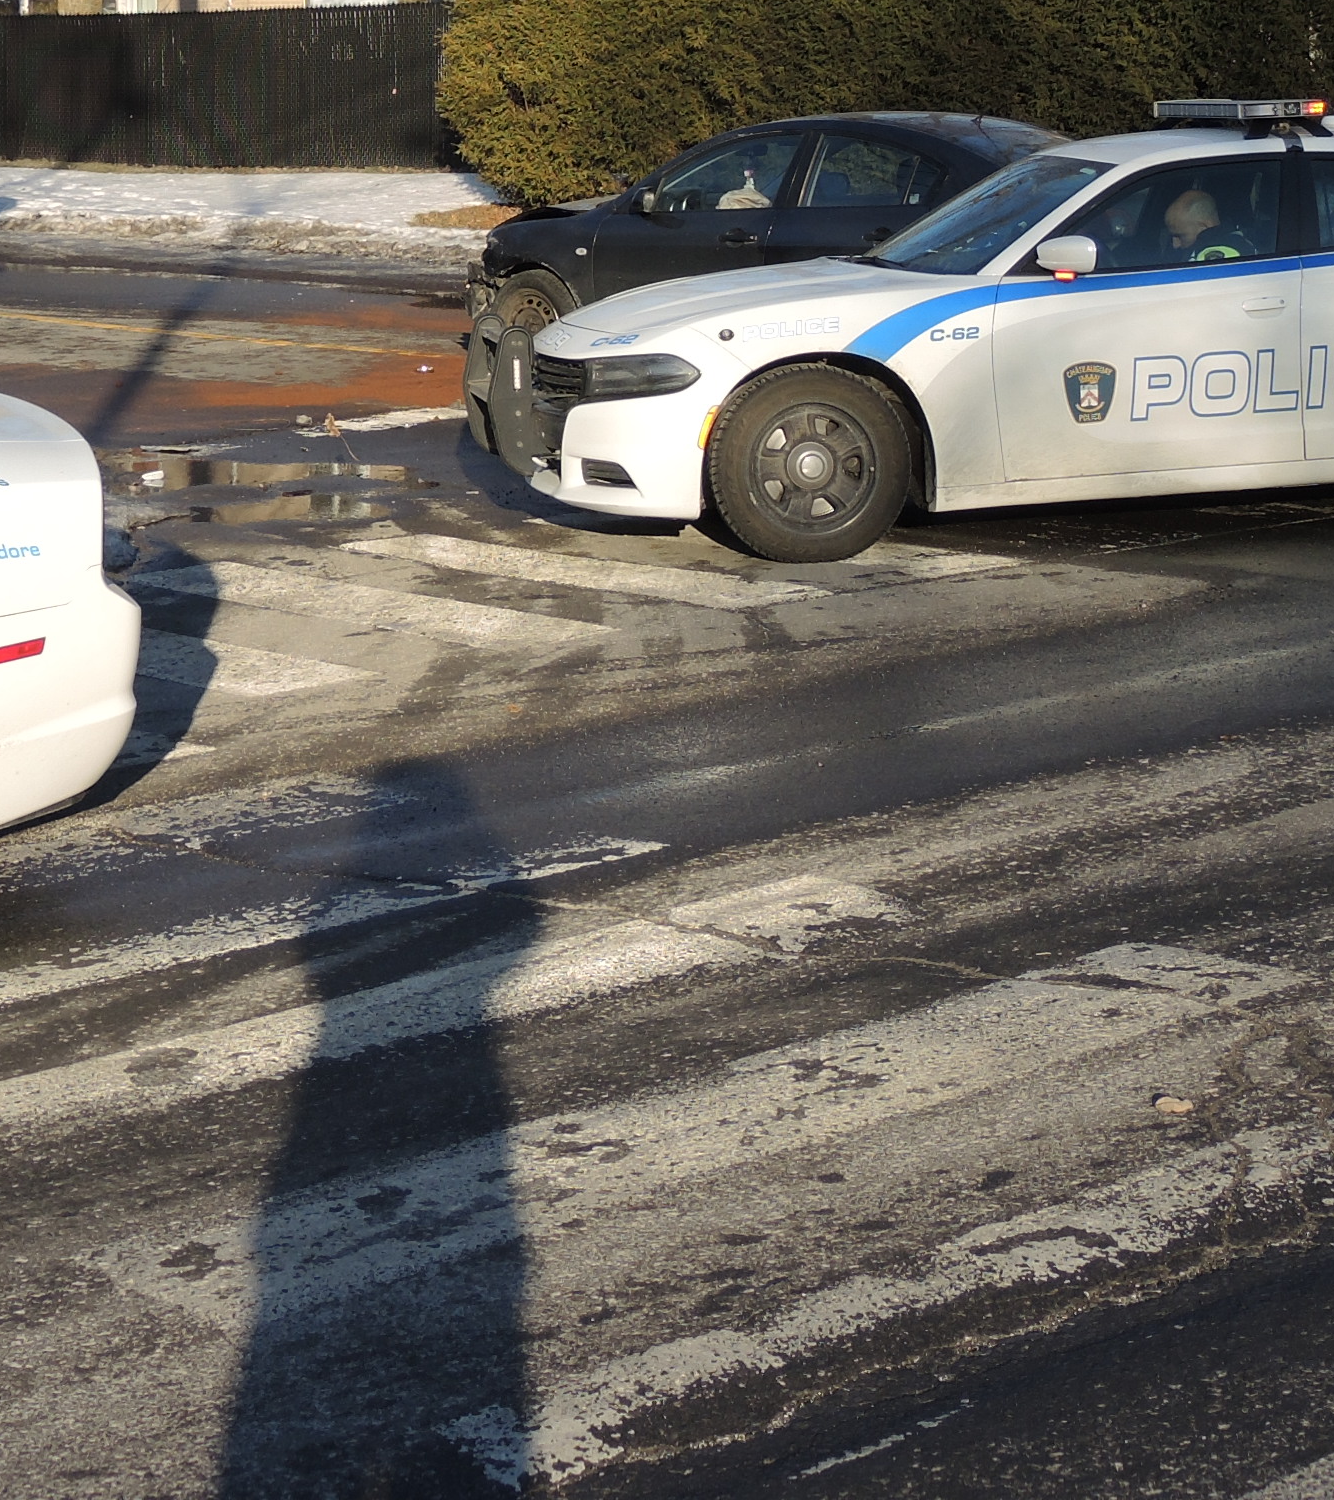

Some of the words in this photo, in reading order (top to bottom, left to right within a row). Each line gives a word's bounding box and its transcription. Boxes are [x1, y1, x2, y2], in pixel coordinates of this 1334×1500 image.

[742, 316, 840, 343] POLICE
[930, 326, 980, 342] C-62
[589, 333, 640, 347] C-62
